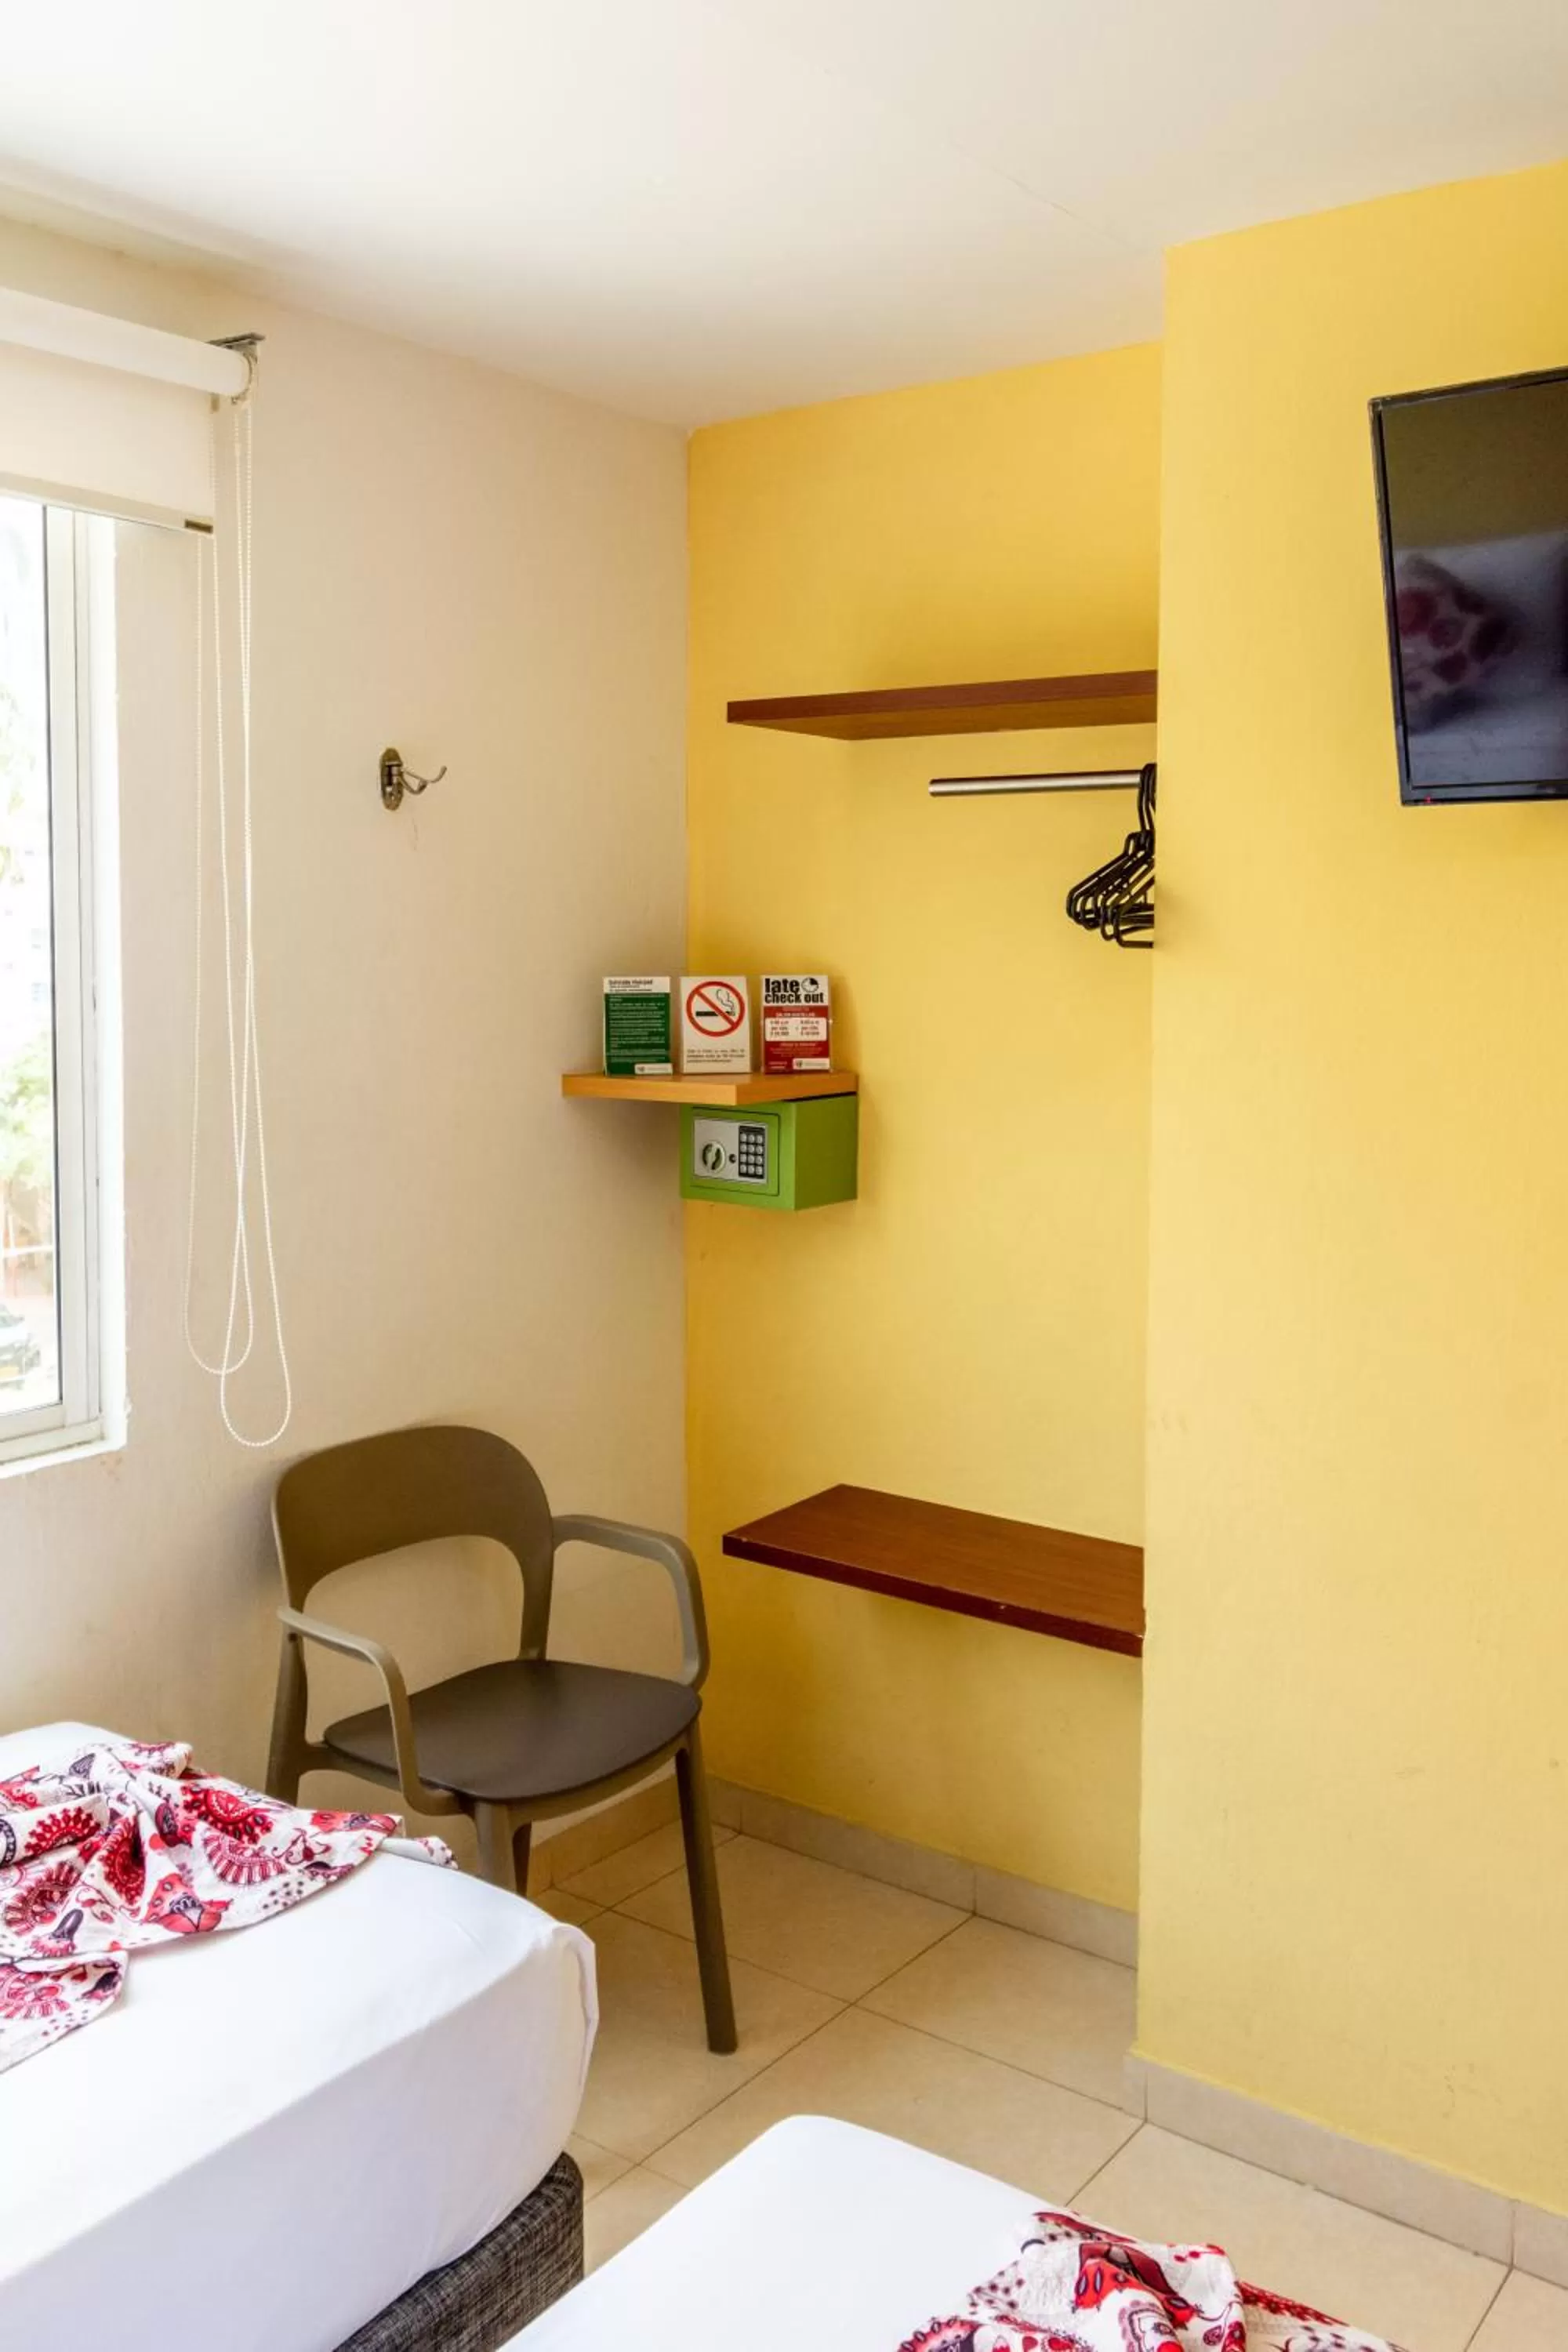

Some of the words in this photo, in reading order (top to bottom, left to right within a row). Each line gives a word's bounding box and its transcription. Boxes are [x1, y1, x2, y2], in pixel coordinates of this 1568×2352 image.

[765, 978, 800, 993] late
[765, 993, 801, 1004] check
[804, 993, 824, 1004] out
